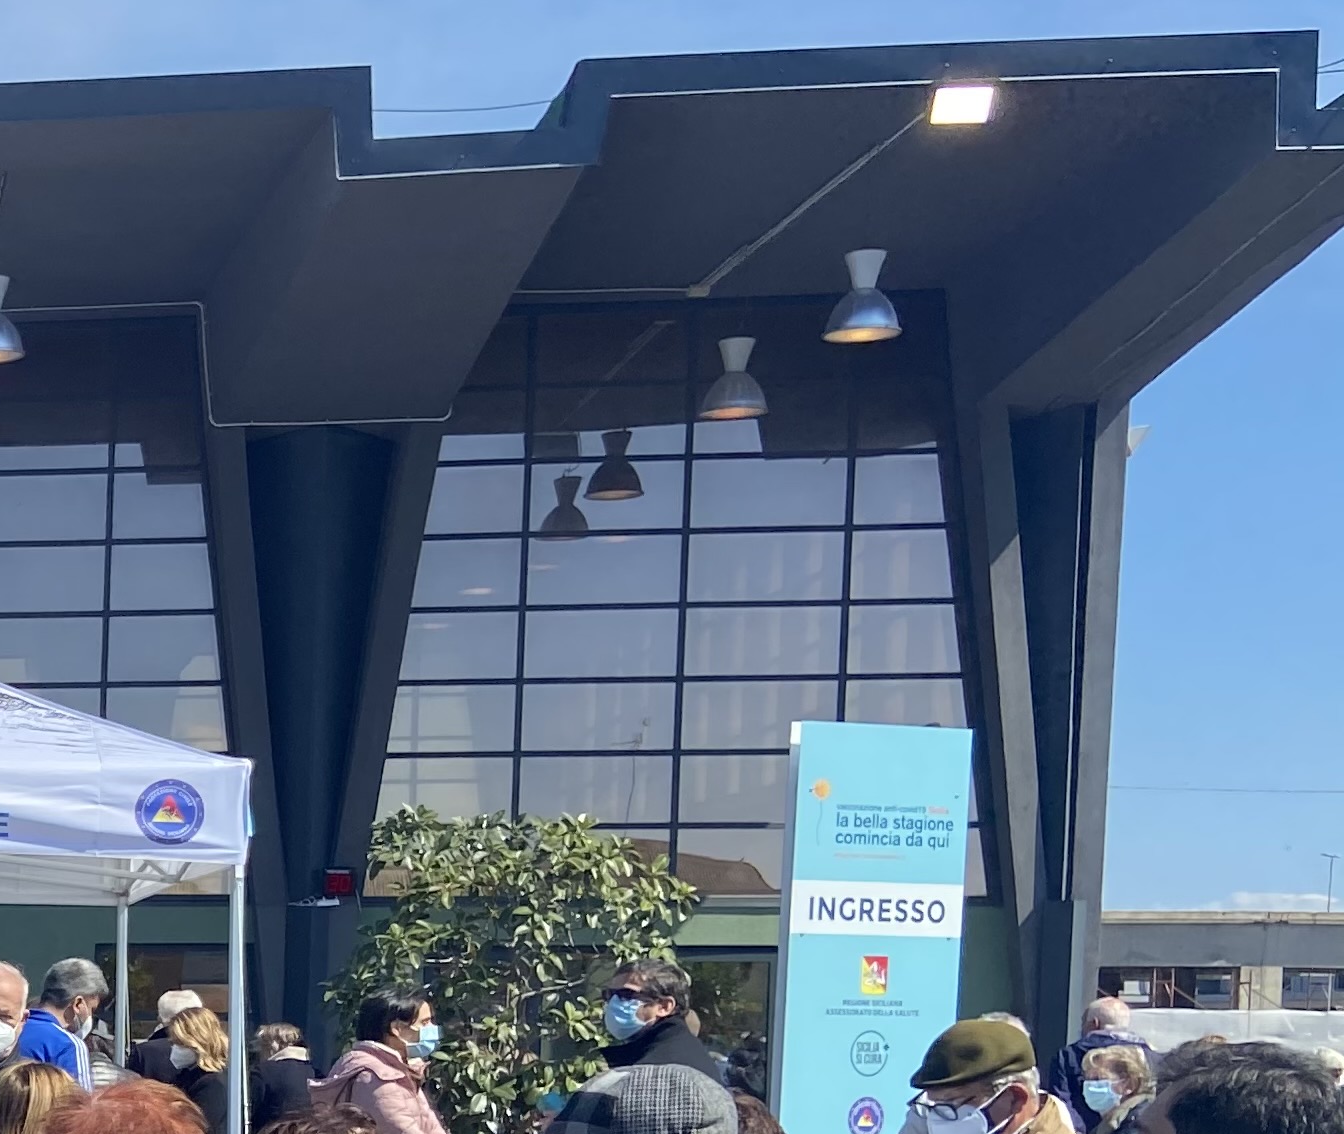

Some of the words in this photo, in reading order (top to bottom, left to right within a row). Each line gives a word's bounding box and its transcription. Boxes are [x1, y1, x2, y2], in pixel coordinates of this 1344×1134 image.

[836, 811, 849, 827] la
[853, 812, 888, 829] bella
[892, 815, 954, 834] stagione
[835, 830, 901, 846] comincia
[905, 832, 923, 847] da
[927, 832, 950, 851] qui
[809, 896, 946, 924] INGRESSO
